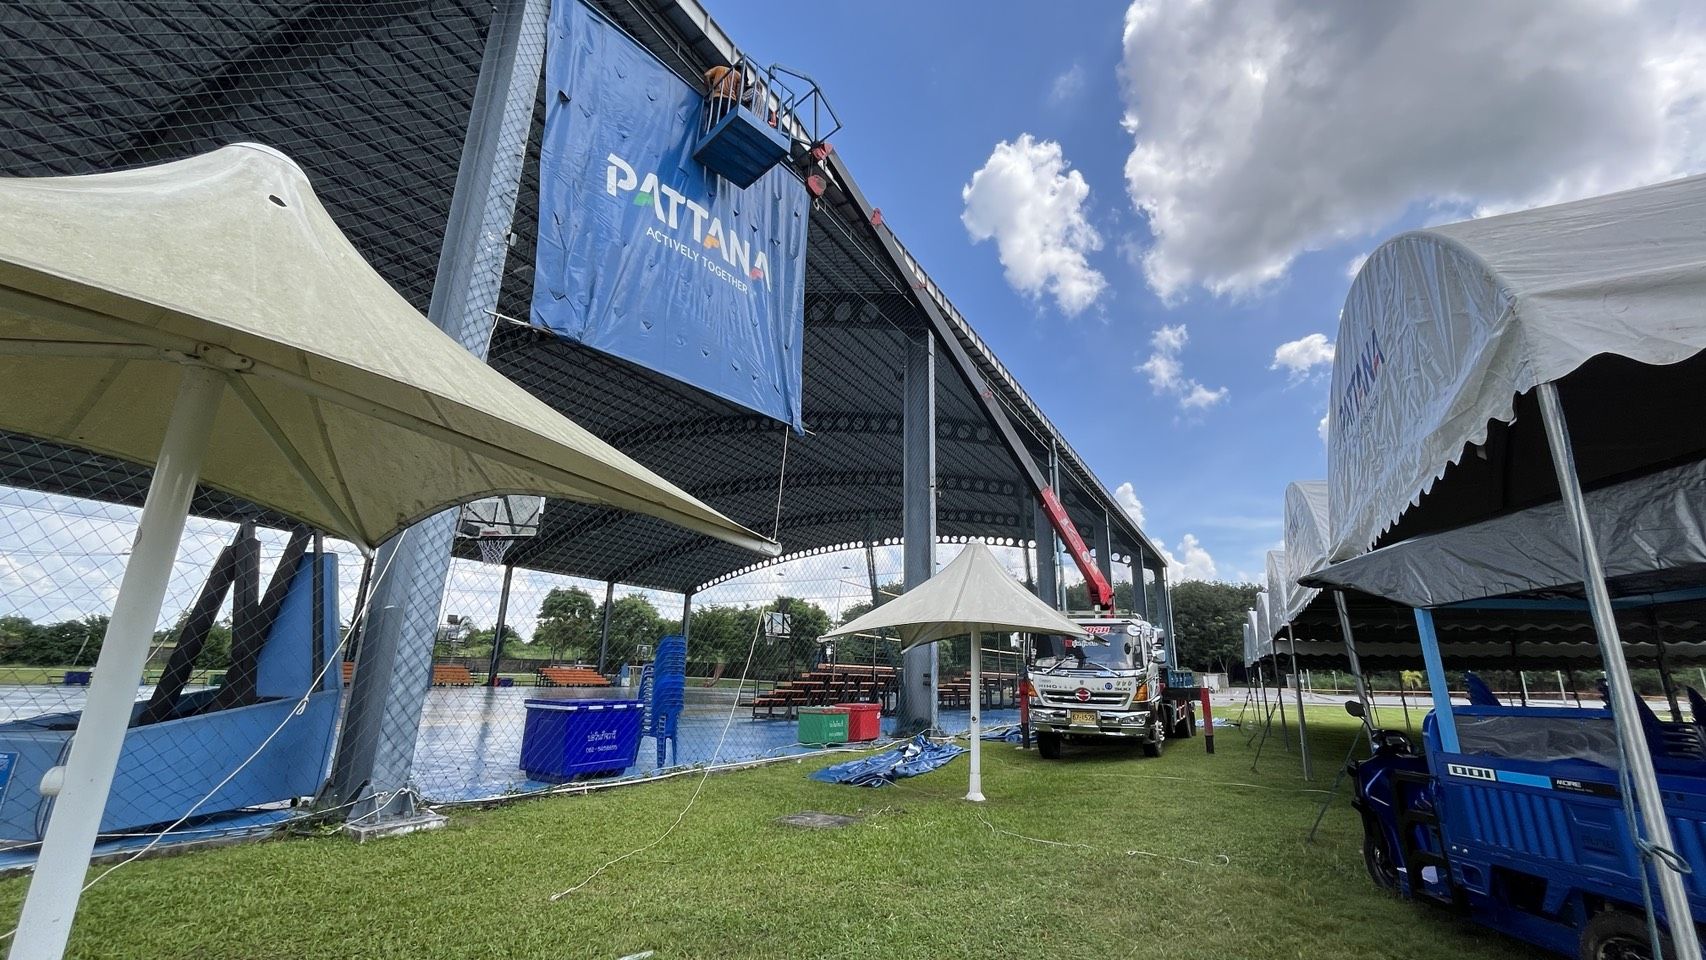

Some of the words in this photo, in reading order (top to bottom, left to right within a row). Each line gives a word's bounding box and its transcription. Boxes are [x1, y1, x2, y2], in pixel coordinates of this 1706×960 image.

[606, 152, 772, 293] PATTANA
[646, 226, 700, 262] ACTIVELY
[701, 256, 748, 295] TOGETHER
